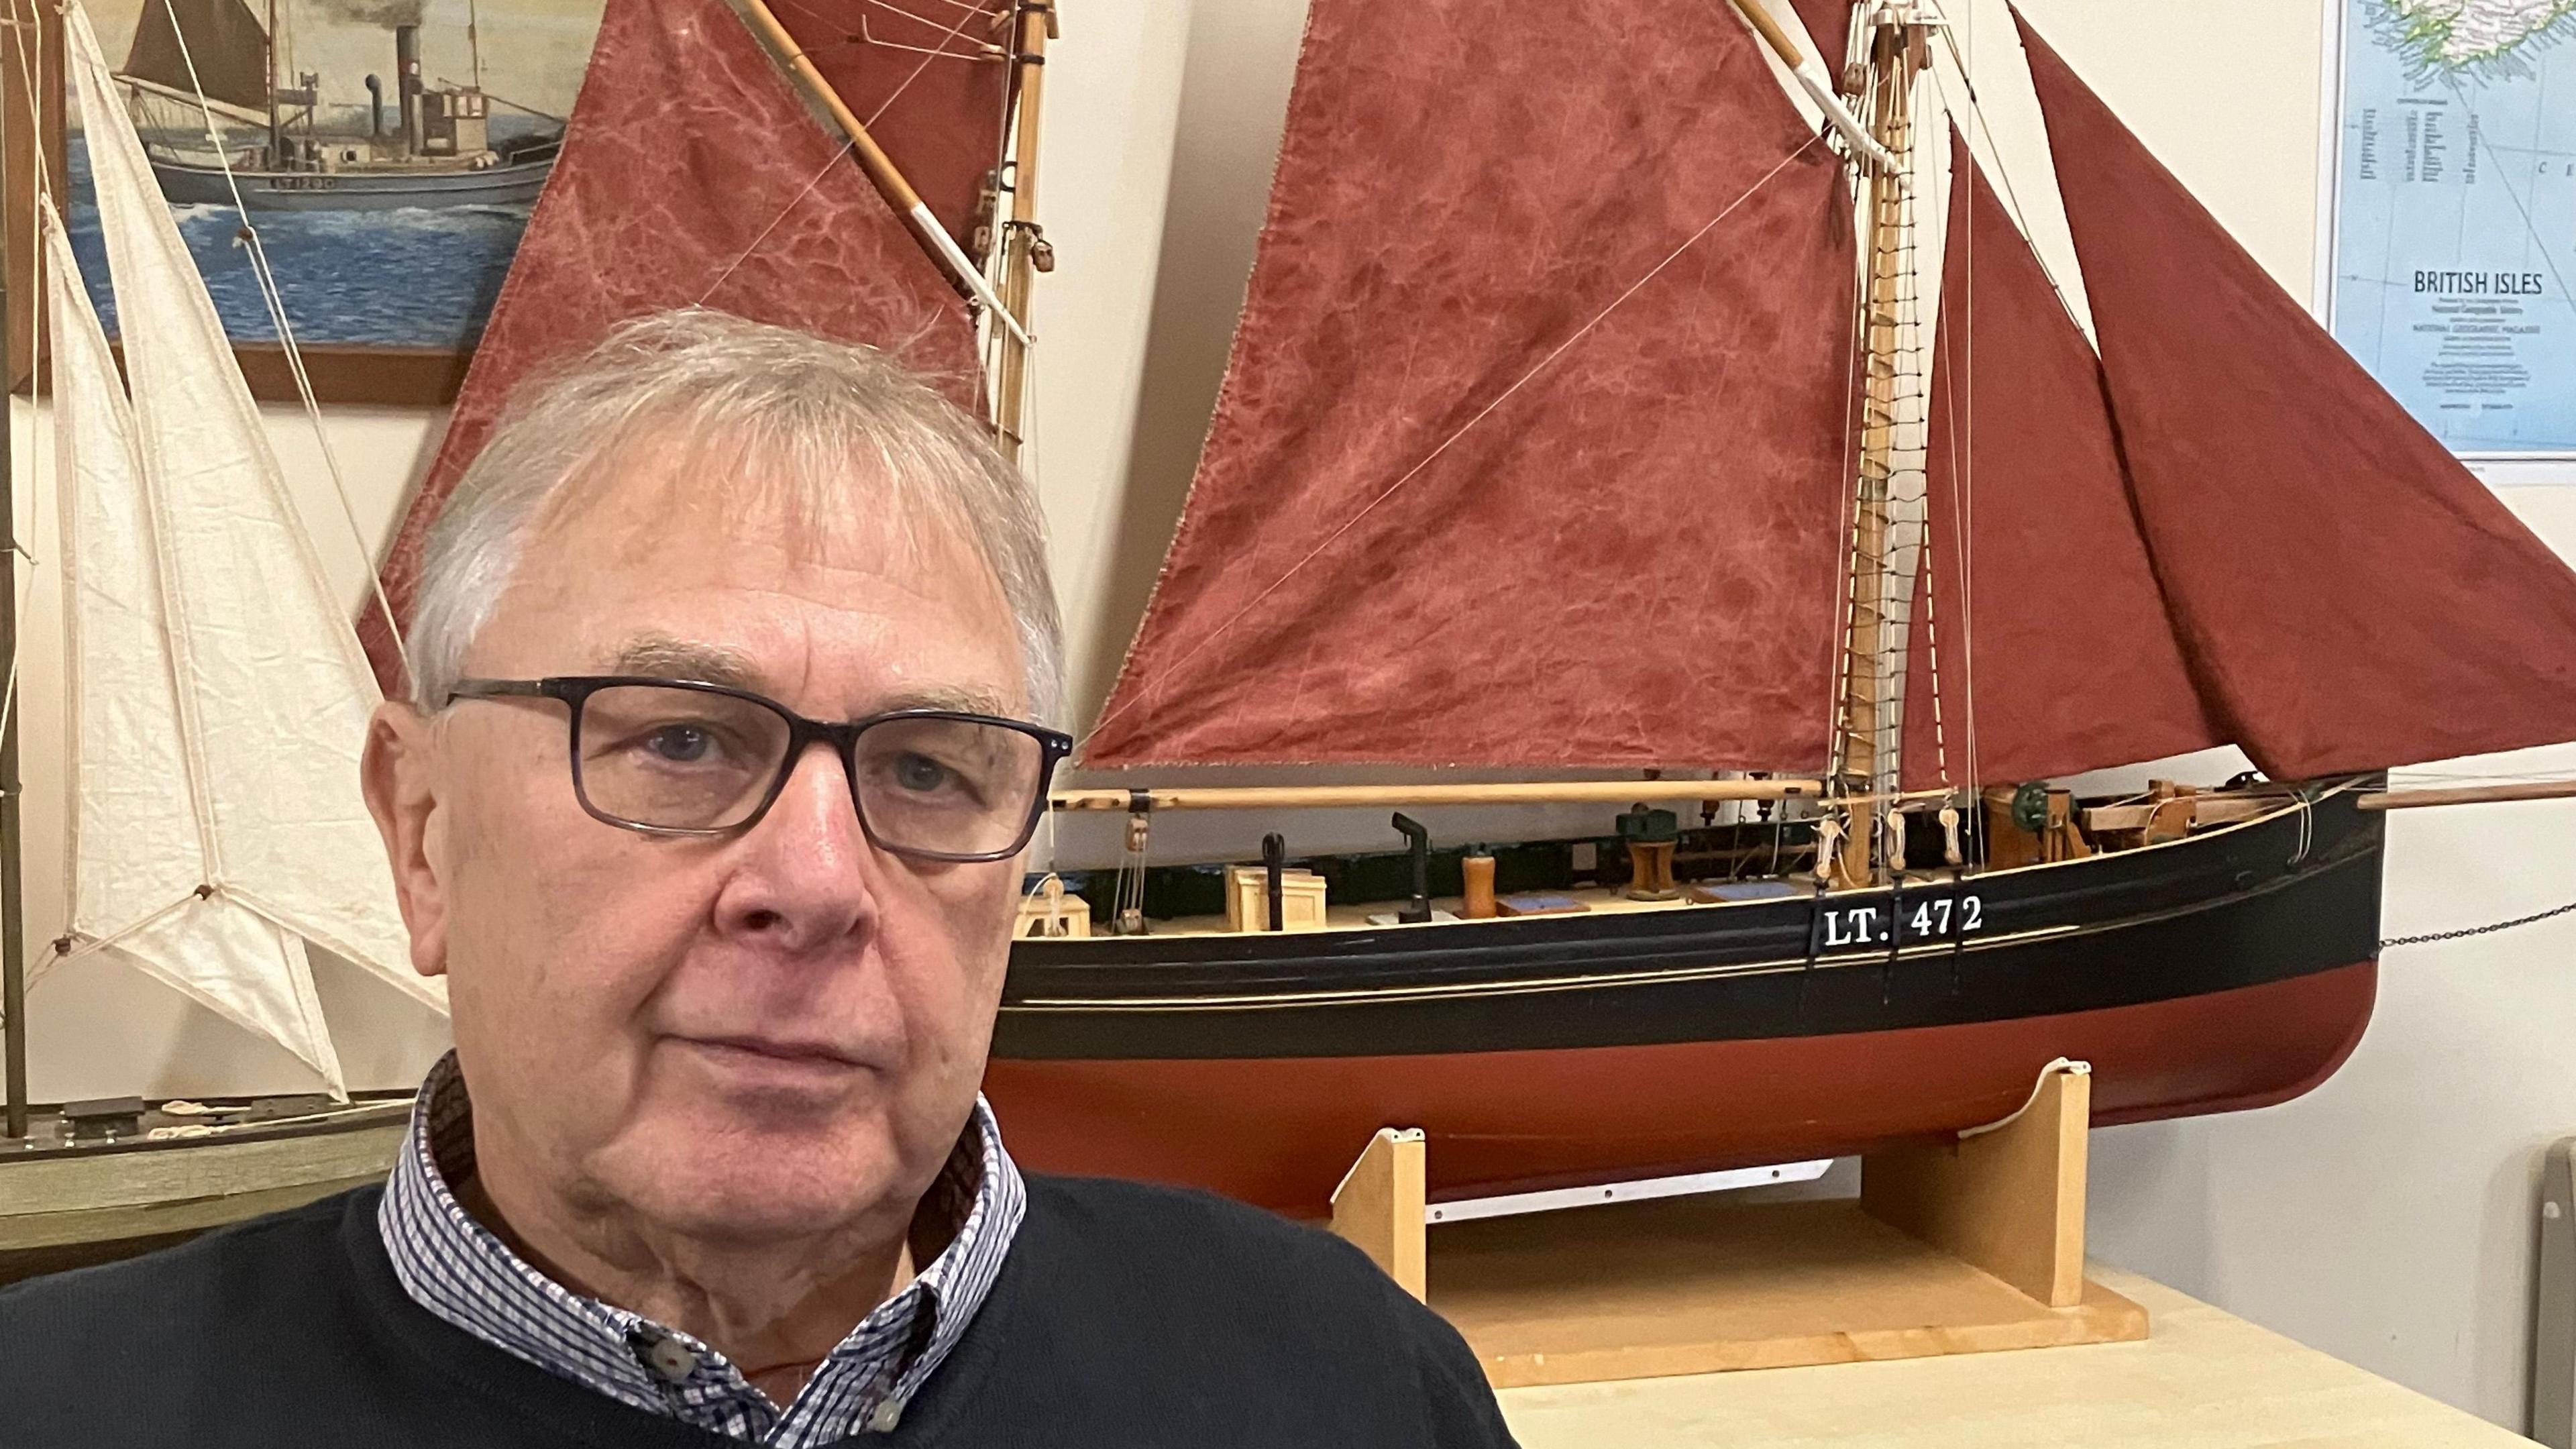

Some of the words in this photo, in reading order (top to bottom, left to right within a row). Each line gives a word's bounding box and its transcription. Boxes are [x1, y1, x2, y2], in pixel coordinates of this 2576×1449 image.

[2415, 270, 2487, 294] BRITISH
[2495, 273, 2542, 294] ISLES
[1824, 908, 1888, 947] LT.
[1911, 896, 1982, 936] 472
